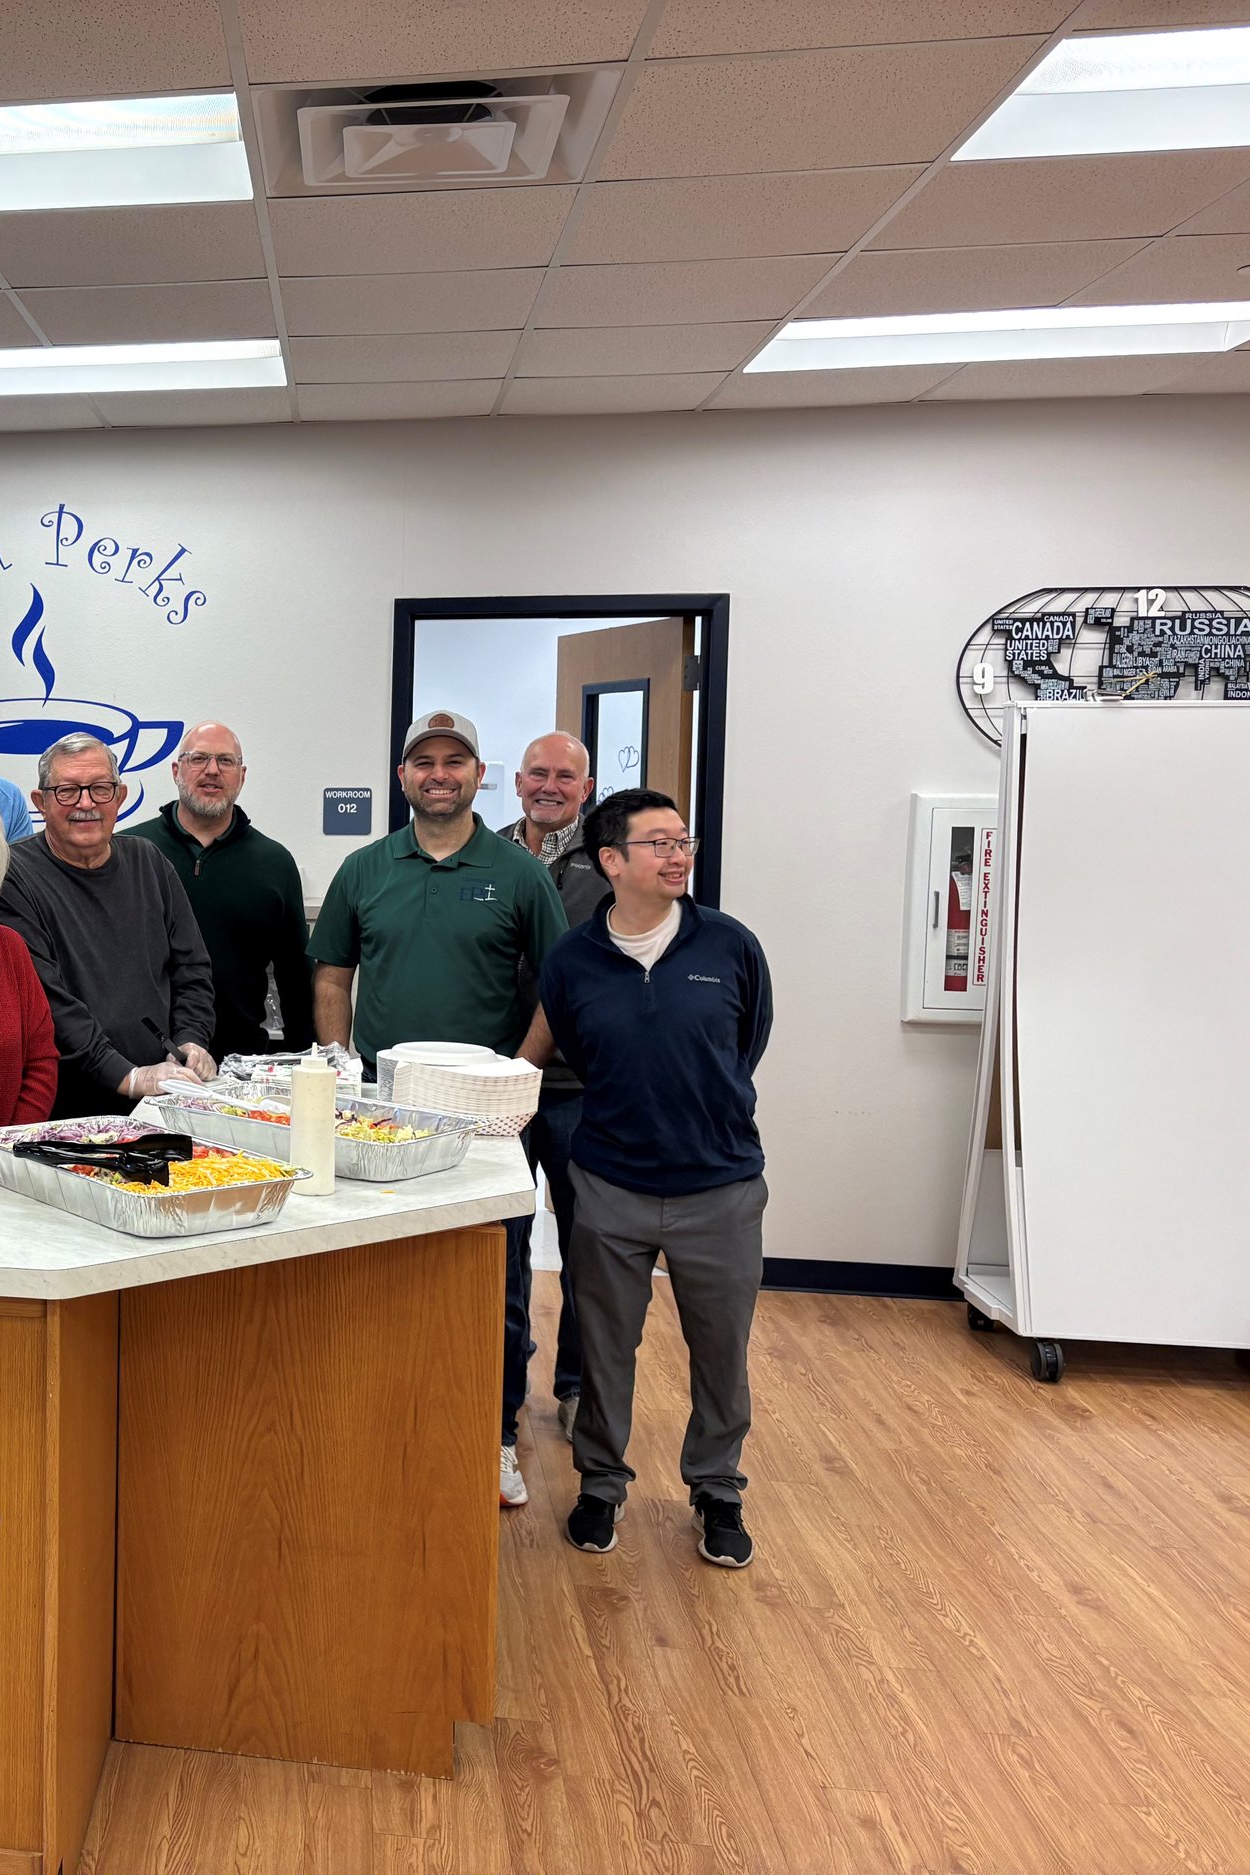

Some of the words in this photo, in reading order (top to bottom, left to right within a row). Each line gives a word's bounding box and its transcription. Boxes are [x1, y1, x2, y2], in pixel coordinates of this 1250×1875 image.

[40, 503, 207, 625] Perks
[1134, 588, 1166, 617] 12
[1012, 621, 1073, 639] CANADA
[1155, 618, 1250, 635] RUSSIA
[1007, 640, 1047, 650] UNITED
[1204, 636, 1236, 645] MONGOLIA
[1006, 650, 1047, 660] STATES
[1201, 644, 1244, 658] CHINA
[1225, 659, 1244, 667] CHINA
[973, 662, 994, 694] 9
[325, 790, 370, 799] WORKROOM
[337, 803, 357, 813] 012
[983, 831, 994, 867] FIRE
[976, 872, 991, 982] EXTINGUISHER
[694, 975, 721, 983] Columbia
